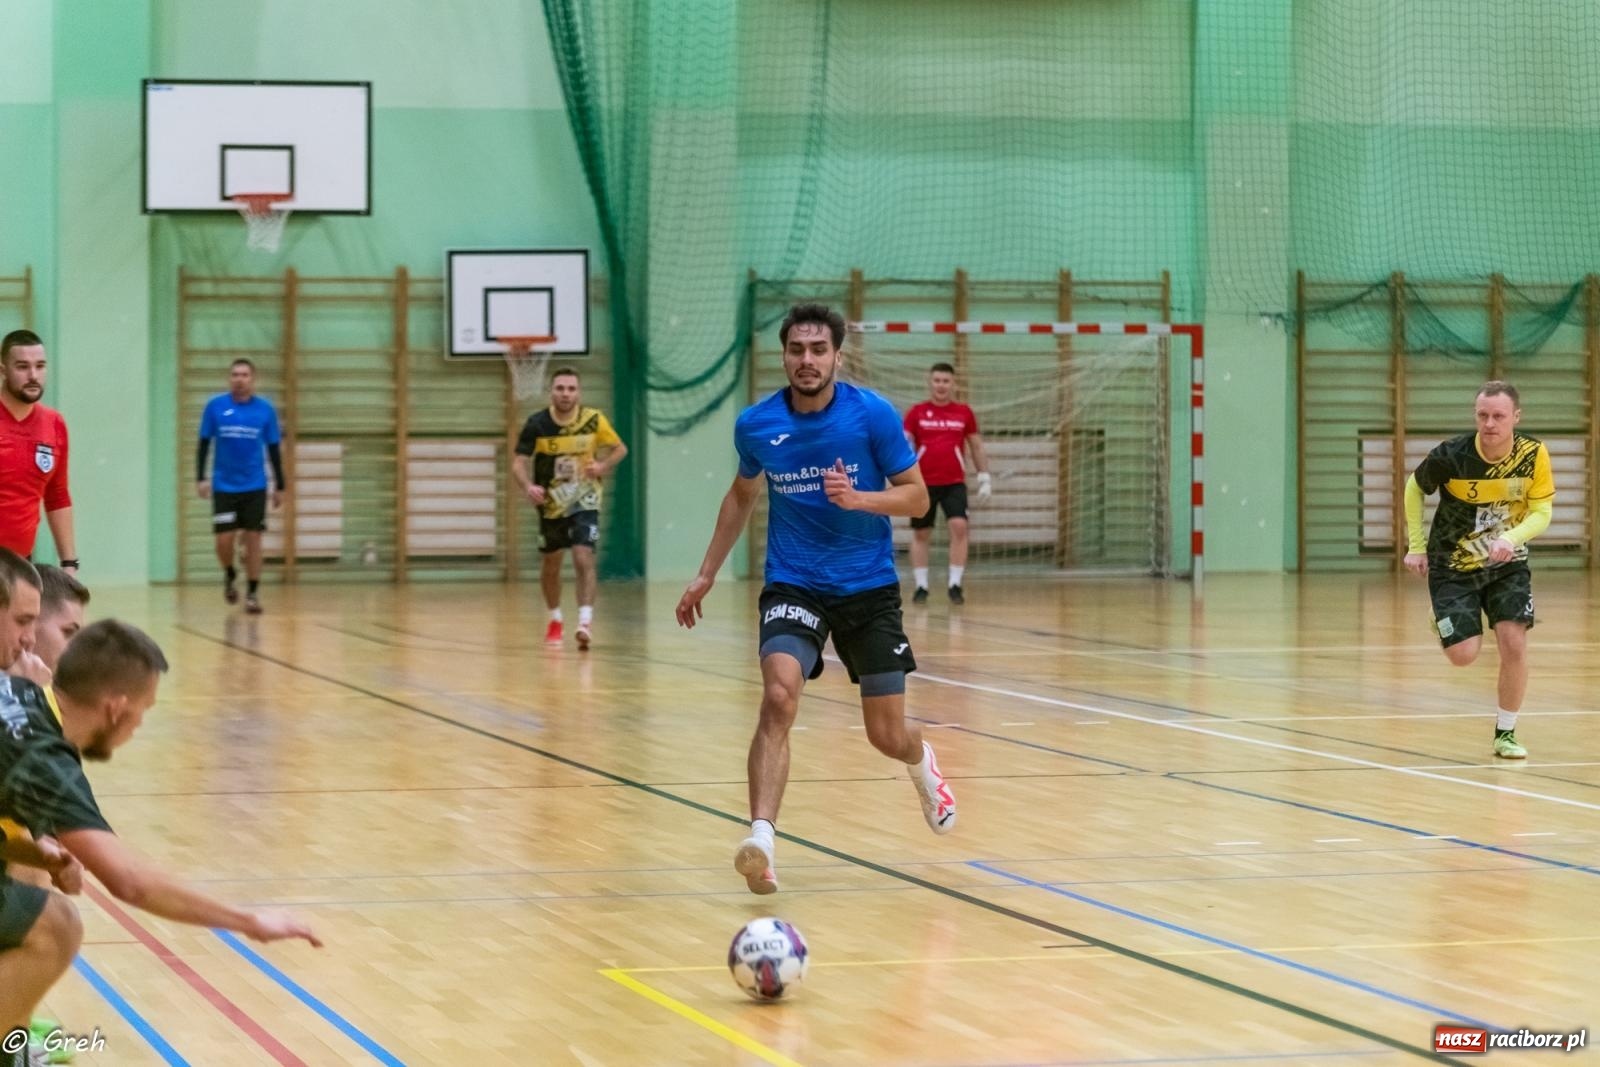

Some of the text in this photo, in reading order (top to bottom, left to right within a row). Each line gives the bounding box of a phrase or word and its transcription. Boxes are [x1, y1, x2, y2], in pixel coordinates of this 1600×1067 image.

[1467, 481, 1478, 499] 3
[764, 603, 820, 630] LSM SPORT
[742, 940, 784, 955] SELECT
